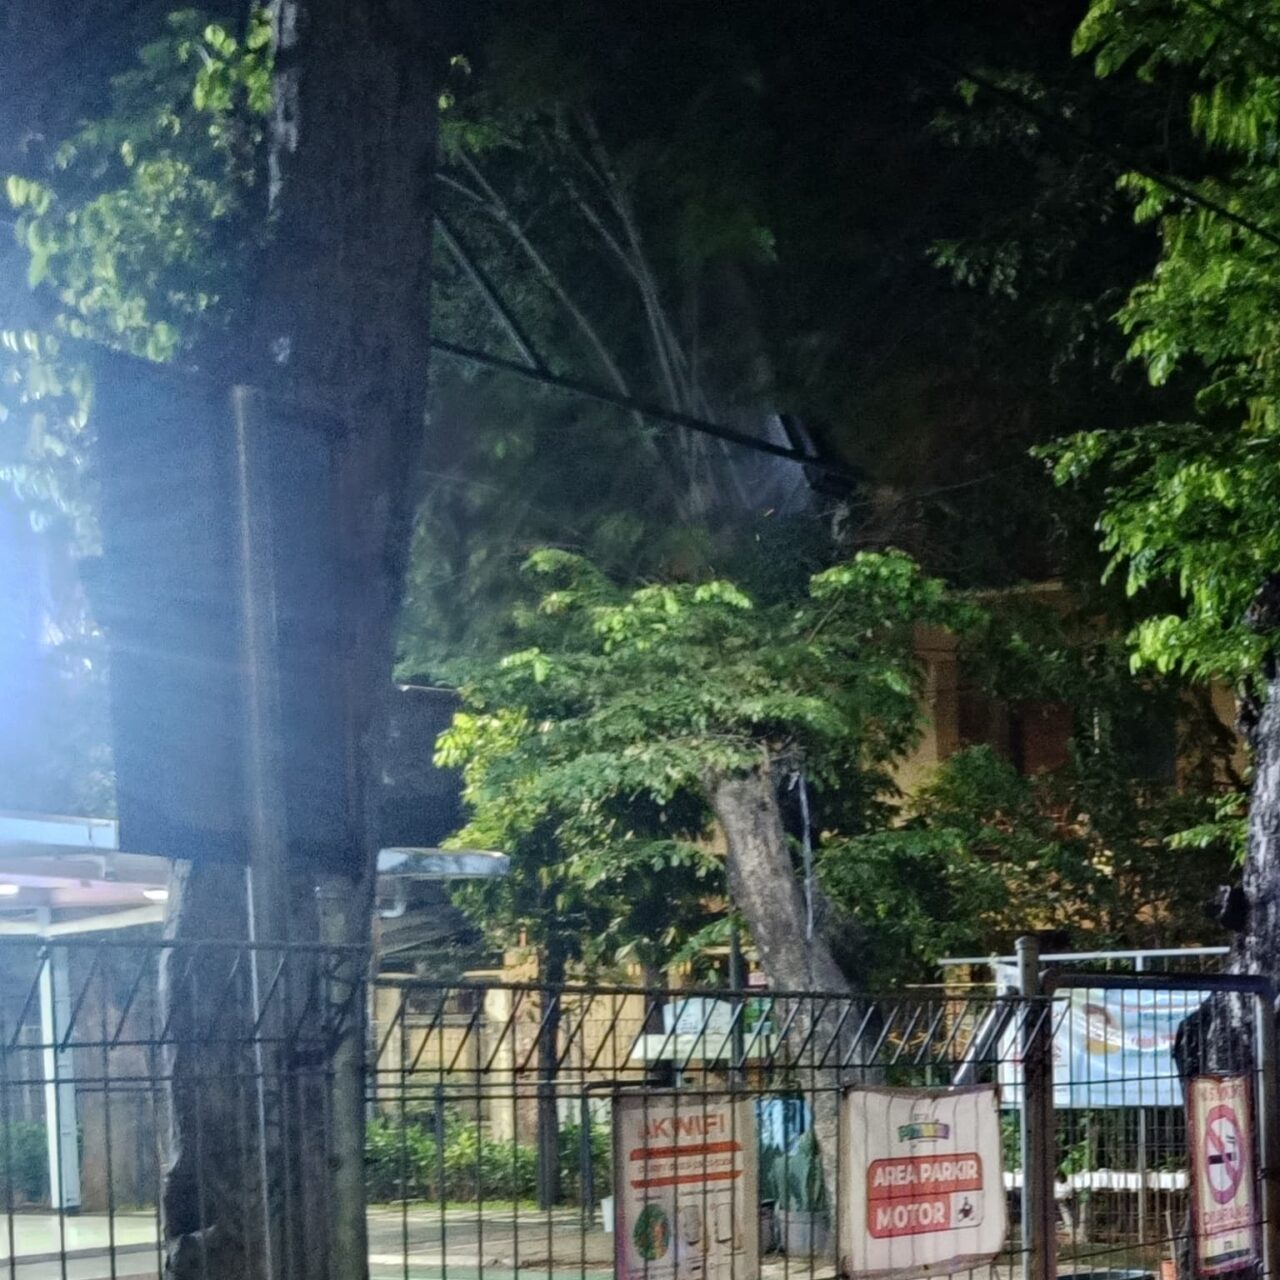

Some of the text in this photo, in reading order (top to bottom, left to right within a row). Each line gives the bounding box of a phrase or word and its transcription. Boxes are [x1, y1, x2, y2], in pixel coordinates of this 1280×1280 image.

[873, 1159, 979, 1188] AREA PARKIR
[876, 1201, 946, 1231] MOTOR
